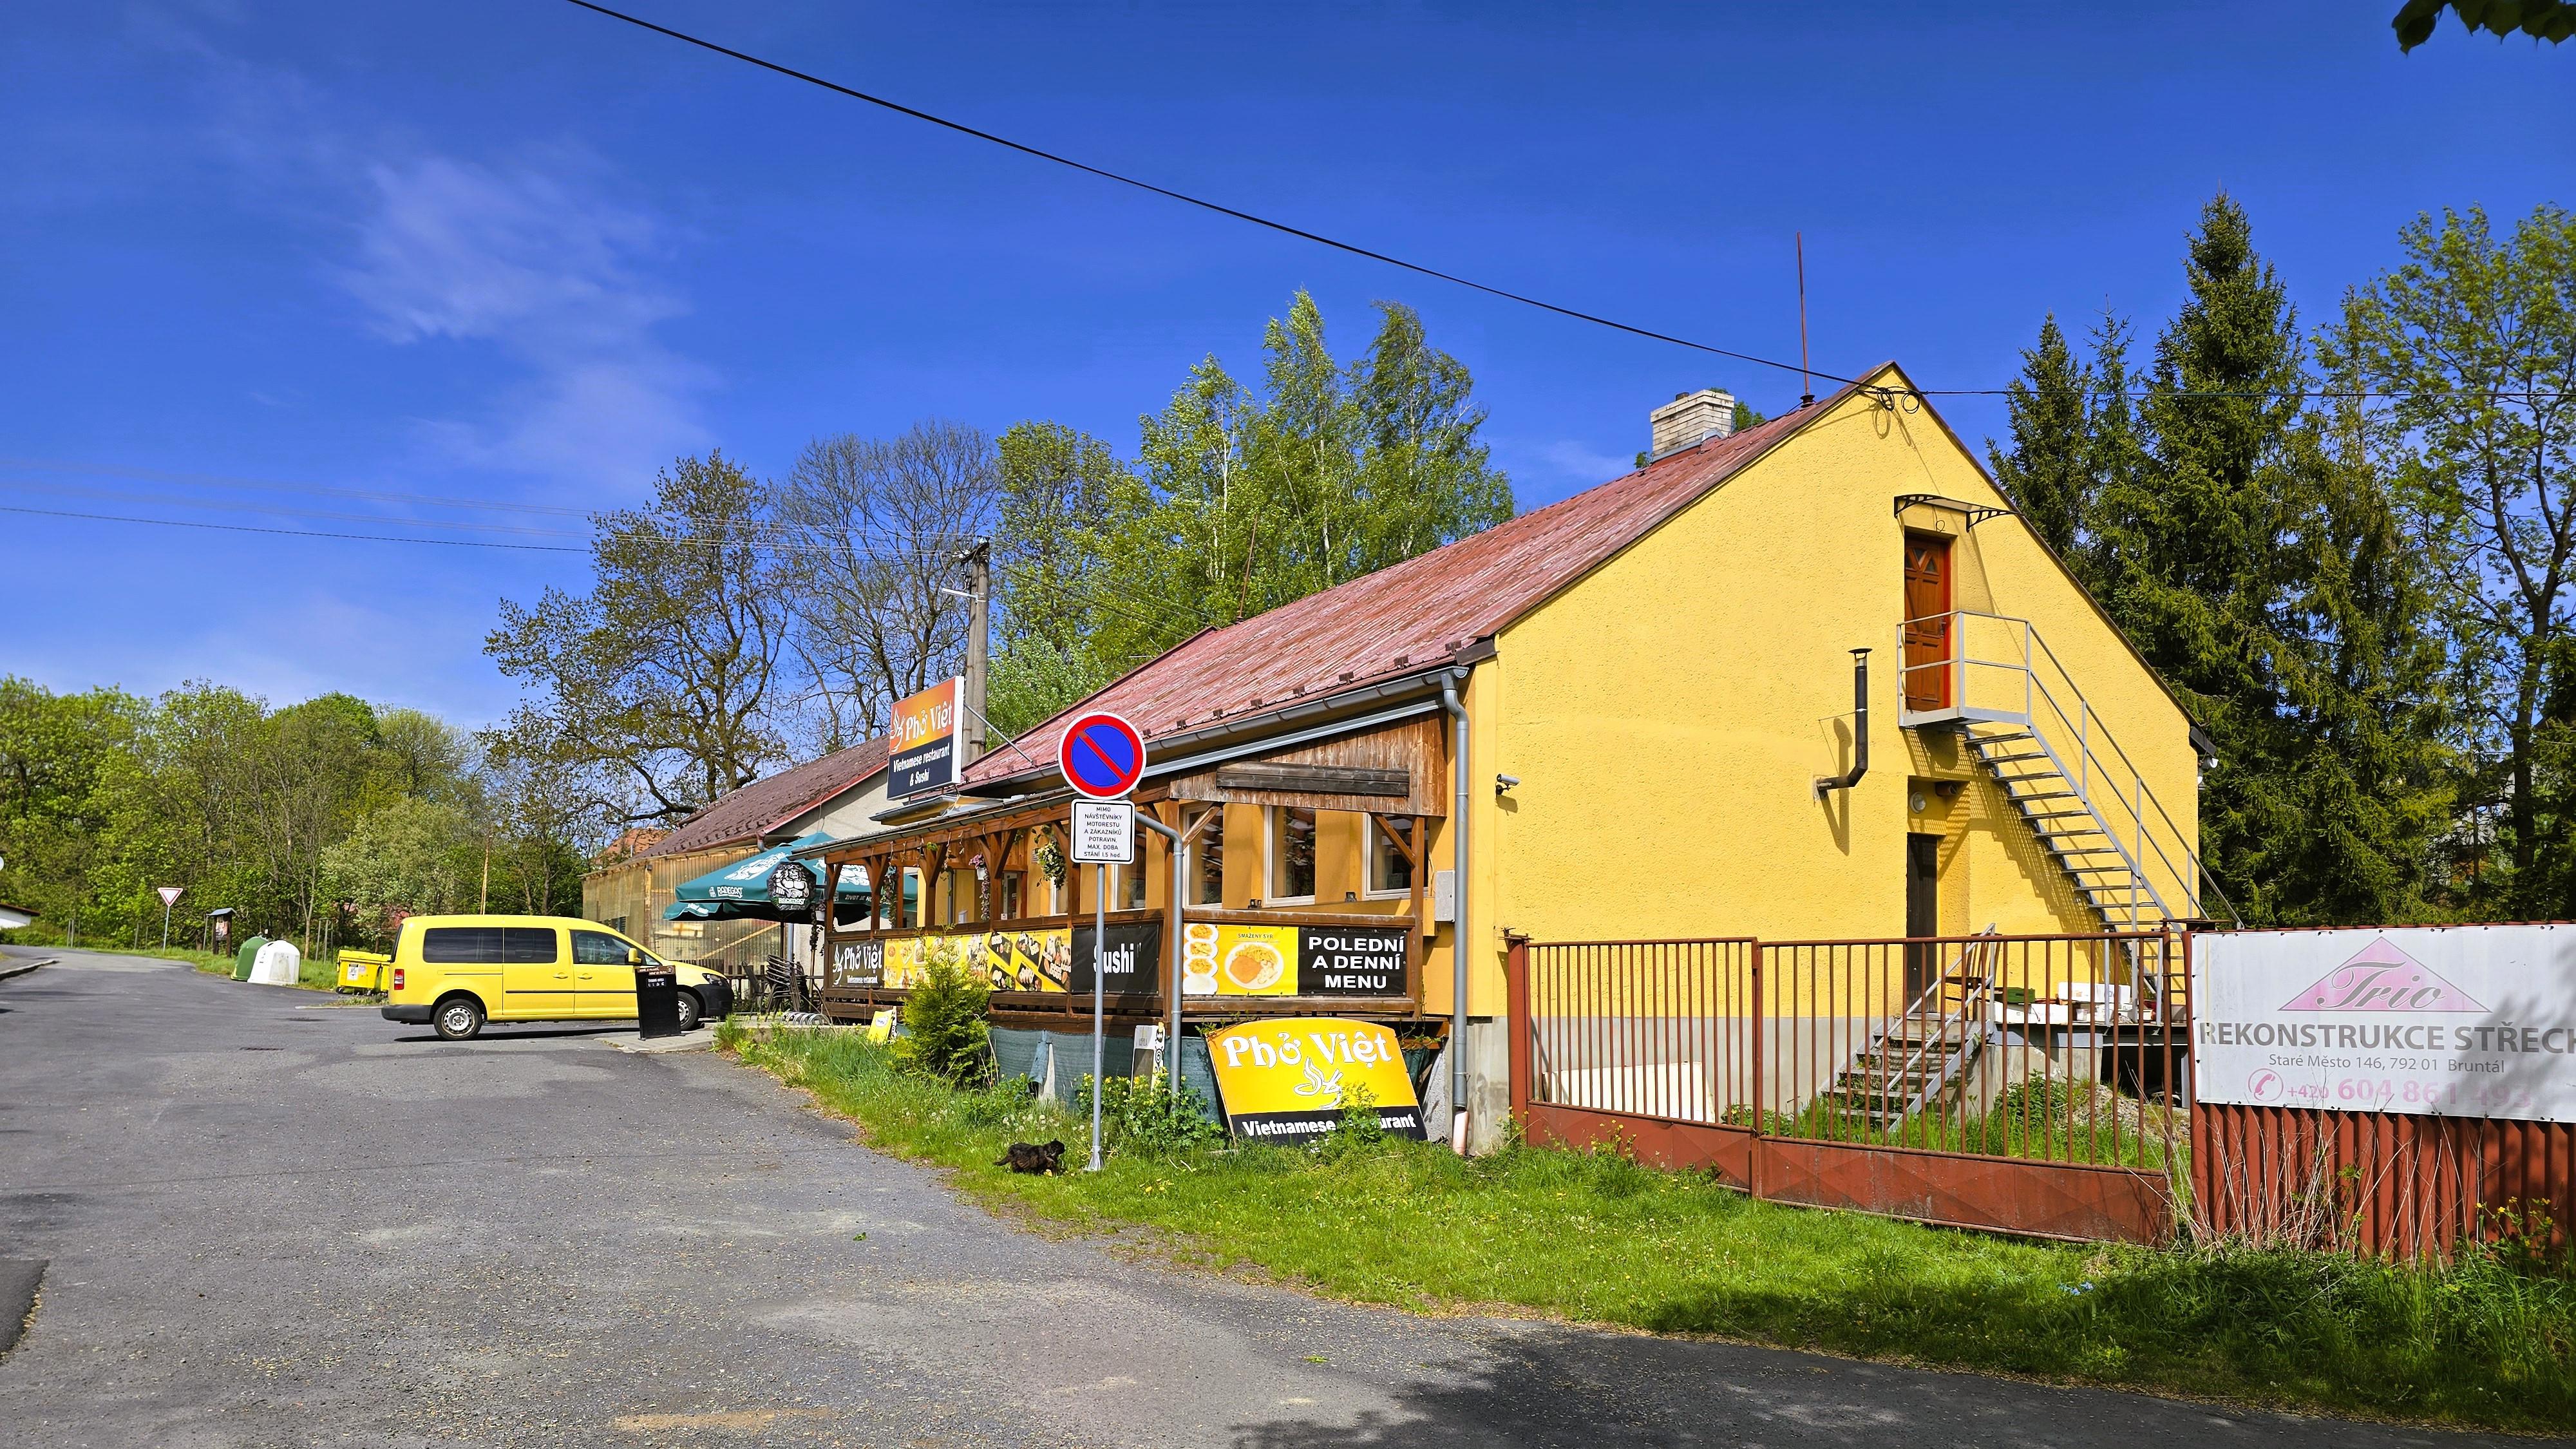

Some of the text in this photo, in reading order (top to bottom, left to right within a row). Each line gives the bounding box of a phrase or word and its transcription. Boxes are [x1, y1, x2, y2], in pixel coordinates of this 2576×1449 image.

[905, 700, 952, 741] Phở Việt
[893, 742, 950, 773] Vietnamese restaurant
[909, 768, 930, 786] & Sushi
[717, 886, 743, 898] RADEGAST
[1308, 936, 1405, 952] POLEDNÍ
[844, 944, 882, 974] Phở Việt
[1312, 954, 1401, 970] A DENNÍ
[1325, 974, 1387, 989] MENU
[2316, 960, 2447, 1009] Trio
[2199, 1022, 2445, 1050] REKONSTRUKCE
[1222, 1030, 1392, 1069] Phở Việt
[2269, 1053, 2505, 1074] Staré Město 146, 792 01 Bruntál
[2338, 1077, 2392, 1102] 604
[2403, 1079, 2457, 1105] 861
[1242, 1119, 1336, 1137] Vietnamese
